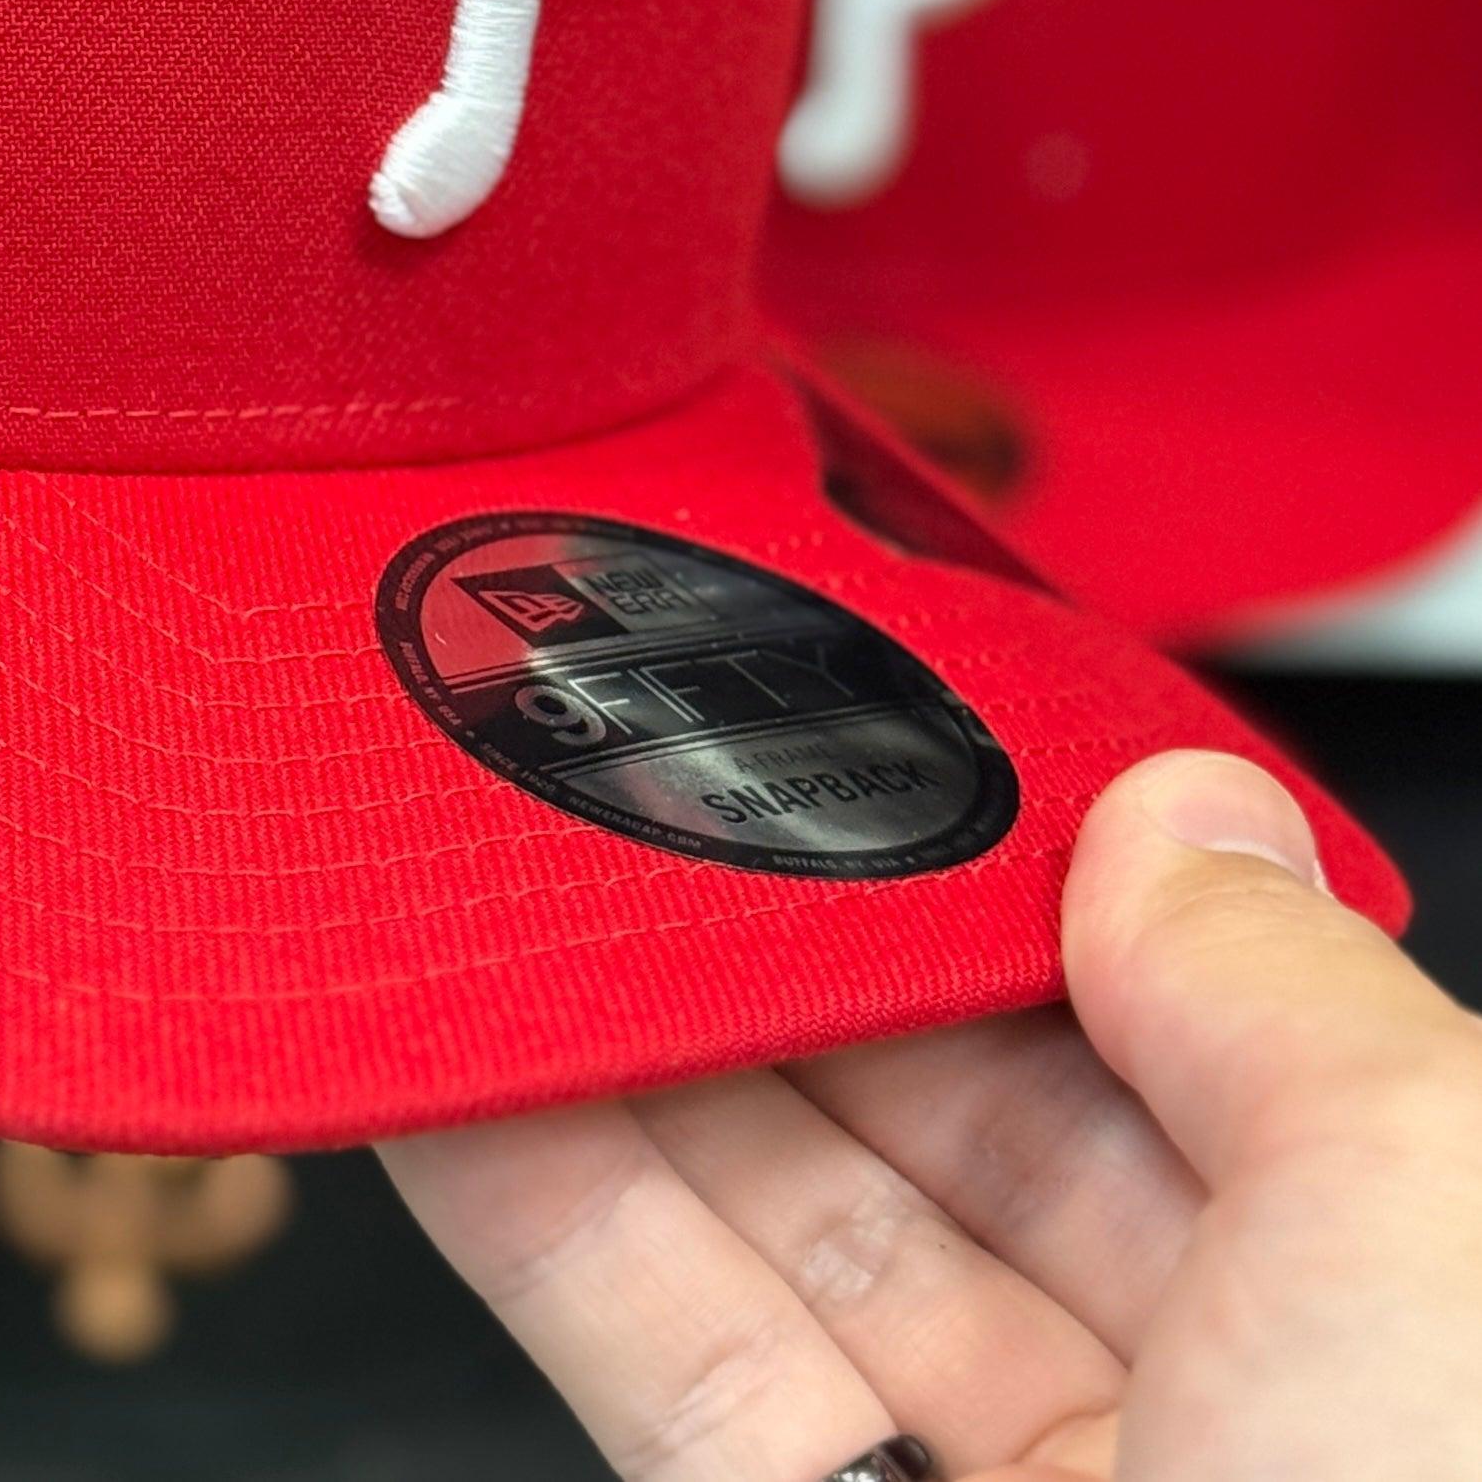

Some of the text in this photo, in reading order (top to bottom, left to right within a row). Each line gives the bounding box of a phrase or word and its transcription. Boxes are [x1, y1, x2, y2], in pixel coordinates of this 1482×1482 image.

[584, 567, 665, 595] NEW
[609, 588, 692, 616] ERA
[514, 644, 856, 749] 9FIFTY
[699, 758, 942, 826] SNAPBACK
